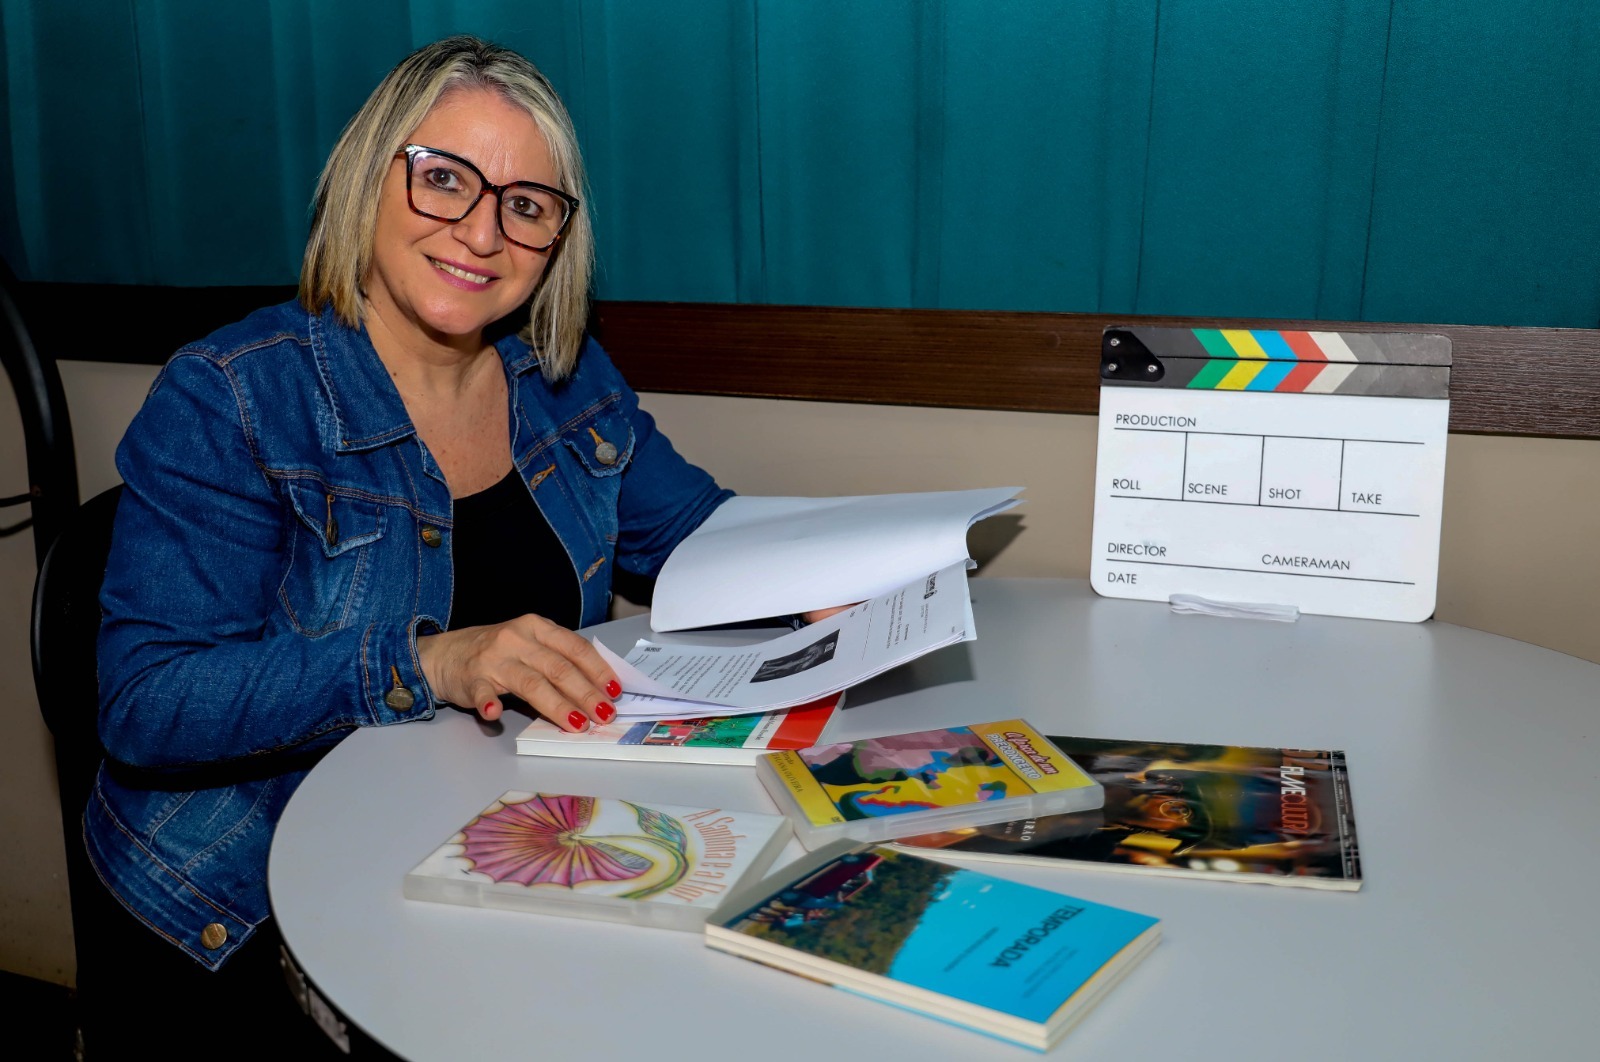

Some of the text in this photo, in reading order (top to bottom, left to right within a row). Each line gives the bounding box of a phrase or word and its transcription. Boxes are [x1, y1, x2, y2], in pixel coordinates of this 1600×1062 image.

[1115, 413, 1197, 428] PRODUCTION
[1112, 478, 1142, 491] ROLL
[1187, 483, 1228, 496] SCENE
[1268, 487, 1302, 501] SHOT
[1351, 492, 1383, 505] TAKE
[1107, 542, 1168, 557] DIRECTOR
[1261, 553, 1351, 571] CAMERAMAN
[1106, 571, 1138, 585] DATE
[985, 733, 1042, 779] PRECONCEITO
[682, 808, 722, 822] A
[694, 816, 747, 859] Sanfona
[667, 879, 727, 904] Flor
[988, 905, 1086, 968] TEMPORADA
